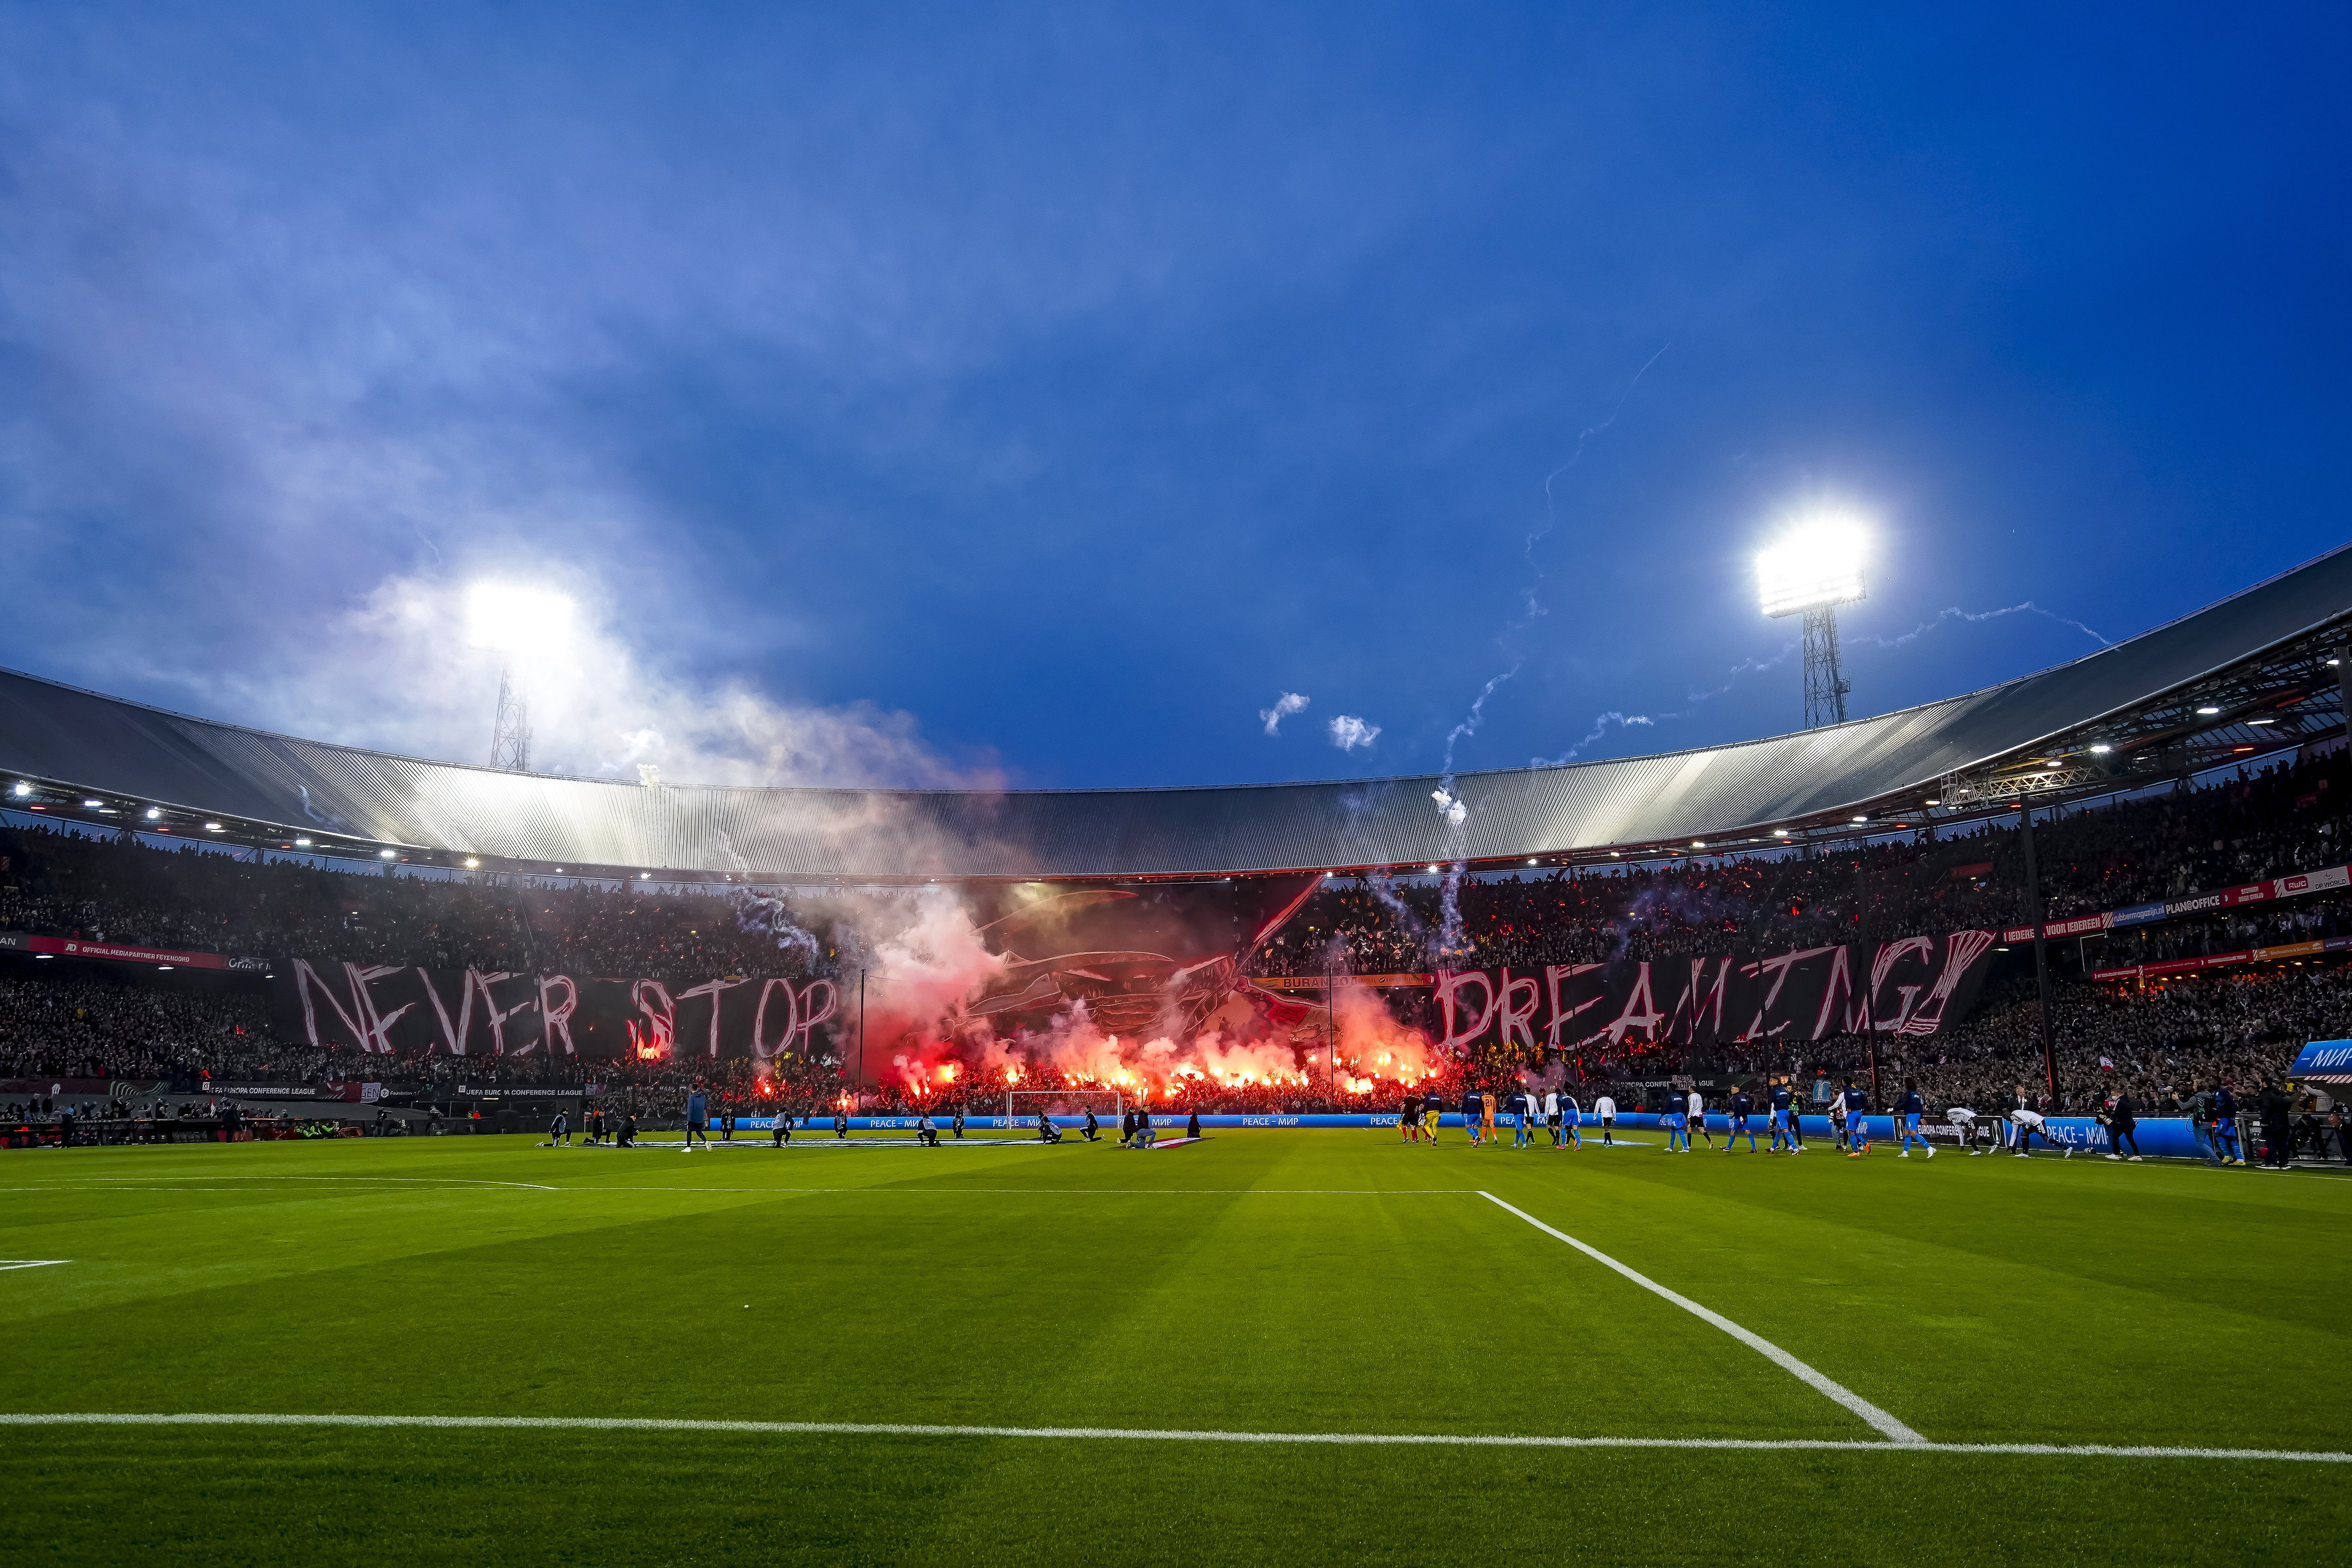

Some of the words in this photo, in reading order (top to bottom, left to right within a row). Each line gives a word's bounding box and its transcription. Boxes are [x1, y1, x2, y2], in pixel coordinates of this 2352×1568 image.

[2114, 905, 2165, 922] rubbermagazijn.nl
[2165, 895, 2221, 915] PLAN@OFFICE
[2045, 923, 2067, 936] VOOR
[2067, 917, 2101, 933] IEDEREEN
[82, 946, 110, 955] OFFICIAL
[110, 949, 155, 959] MEDIAPARTNER
[156, 954, 190, 963] FEYENOORD
[1283, 977, 1349, 988] BURANDO
[292, 959, 578, 1055] NEVER
[626, 977, 838, 1059] STOP
[1485, 1099, 1492, 1107] 21
[1370, 1117, 1397, 1125] PEACE
[1917, 1125, 1936, 1135] EUROPA
